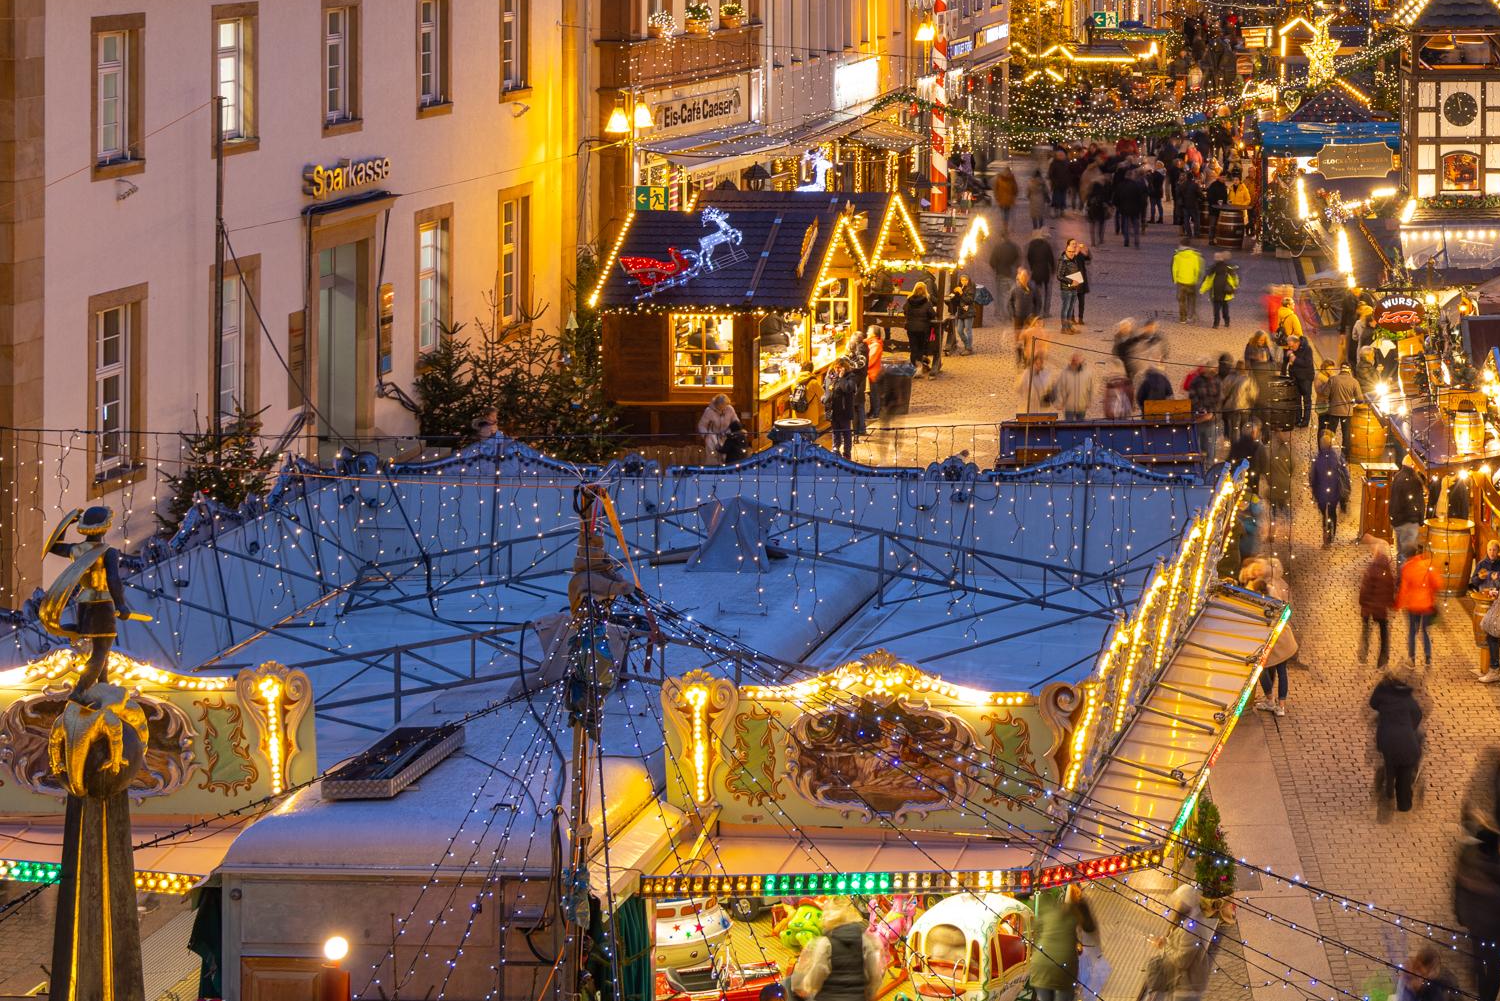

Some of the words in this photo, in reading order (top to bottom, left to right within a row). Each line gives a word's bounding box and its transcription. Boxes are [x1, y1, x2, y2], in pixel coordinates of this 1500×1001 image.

[664, 101, 701, 128] Eis-Café
[312, 157, 391, 201] Sparkasse
[1381, 296, 1420, 309] WURST
